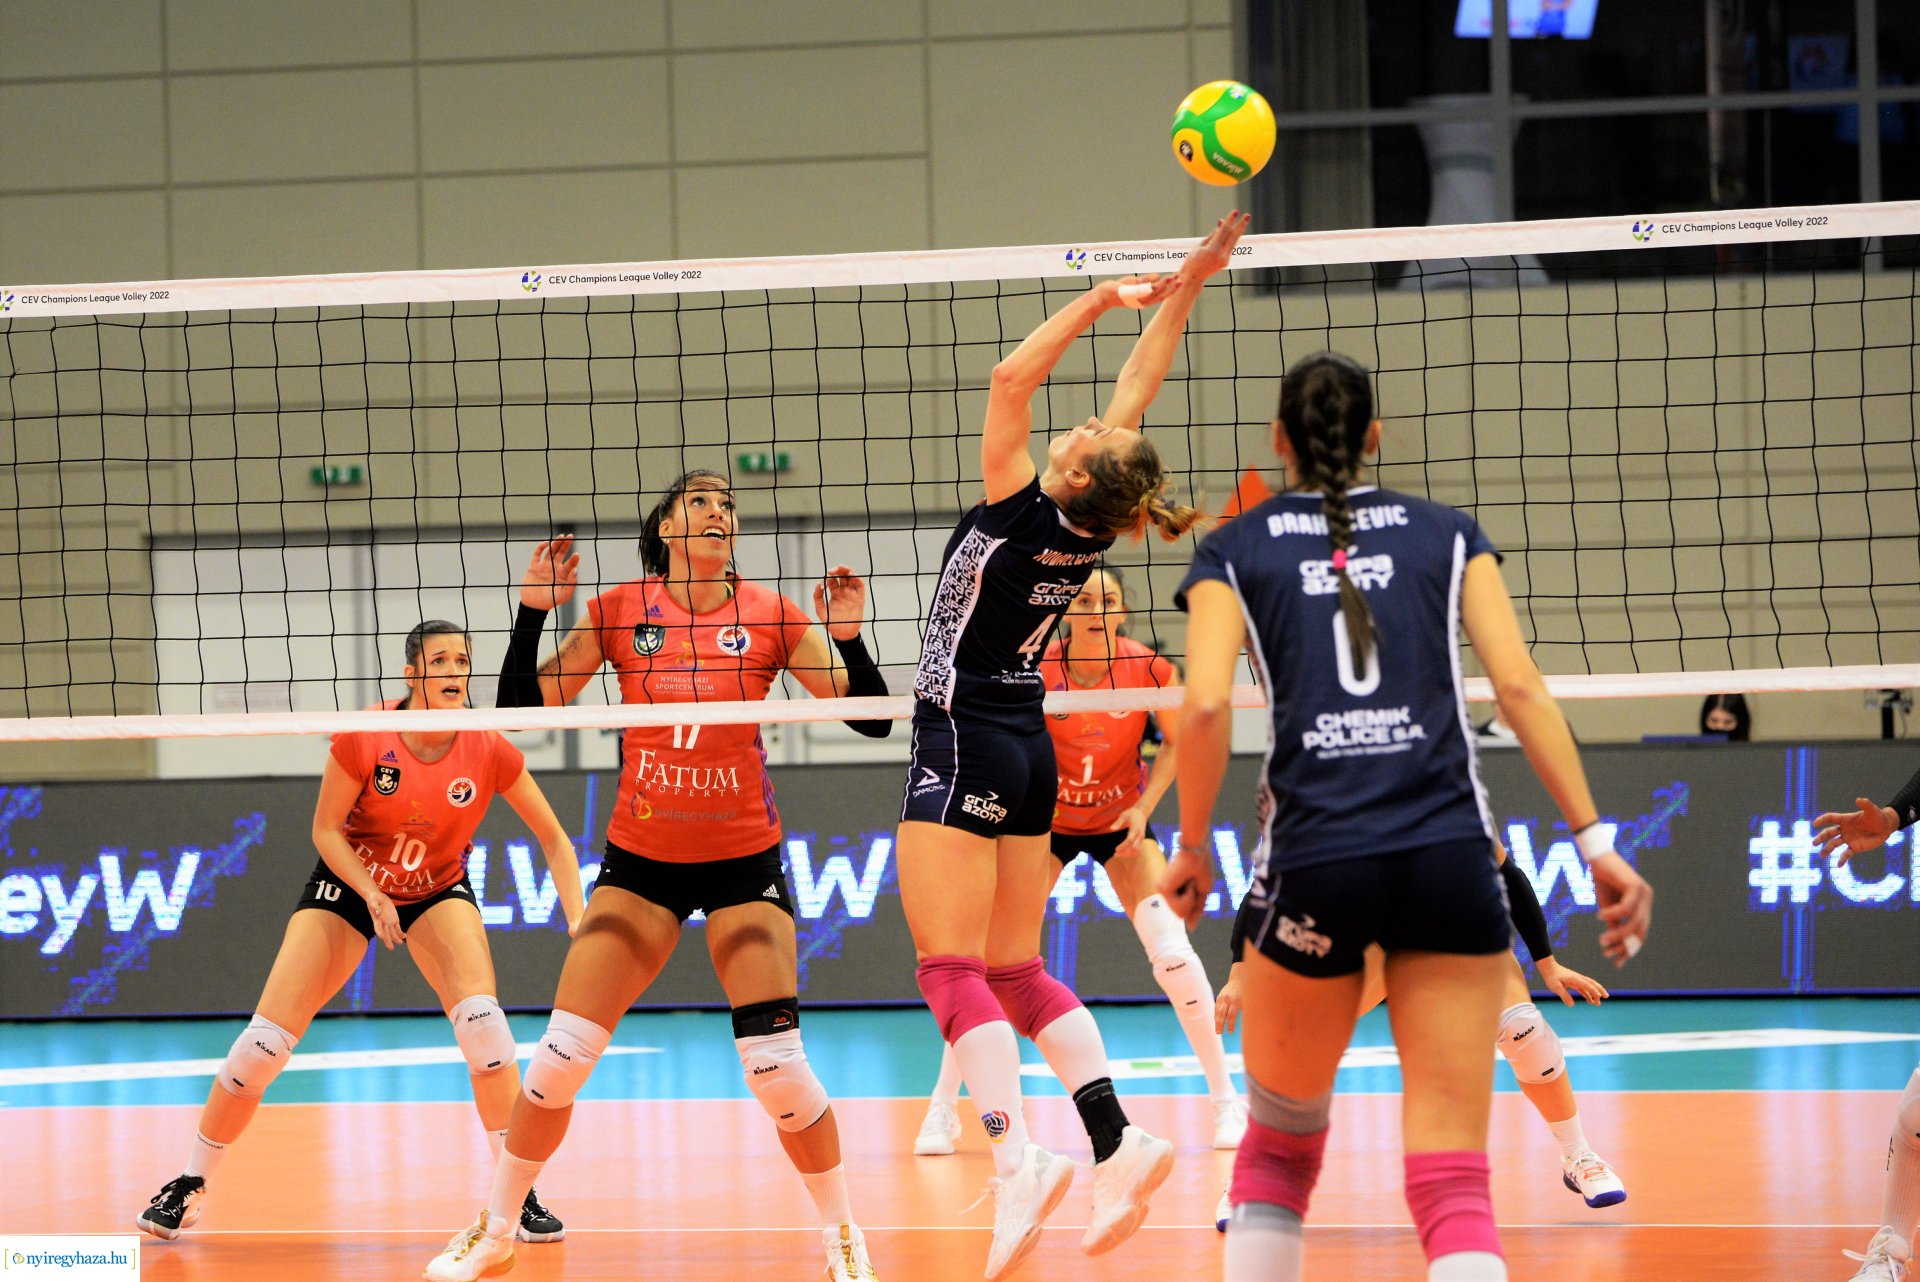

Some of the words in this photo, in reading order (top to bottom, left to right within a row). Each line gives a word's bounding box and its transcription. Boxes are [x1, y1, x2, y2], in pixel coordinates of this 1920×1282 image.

[1662, 224, 1682, 234] CEV
[1684, 222, 1736, 234] Champions
[1738, 220, 1773, 231] League
[1775, 218, 1804, 229] Volley
[1806, 216, 1829, 226] 2022
[1094, 252, 1113, 262] CEV
[1115, 251, 1165, 262] Champions
[1232, 246, 1253, 256] 2022
[548, 275, 567, 285] CEV
[569, 273, 617, 285] Champions
[619, 272, 651, 284] League
[652, 271, 679, 282] Volley
[681, 270, 702, 280] 2022
[21, 295, 40, 304] CEV
[40, 293, 88, 305] Champions
[89, 293, 120, 304] League
[122, 291, 148, 302] Volley
[149, 290, 170, 300] 2022
[1017, 613, 1058, 669] 4
[1315, 705, 1412, 731] CHEMIK
[1302, 725, 1391, 750] POLICE
[1068, 754, 1100, 787] 1
[635, 779, 740, 797] PROPERTY
[389, 832, 427, 872] 10
[315, 879, 342, 902] 10
